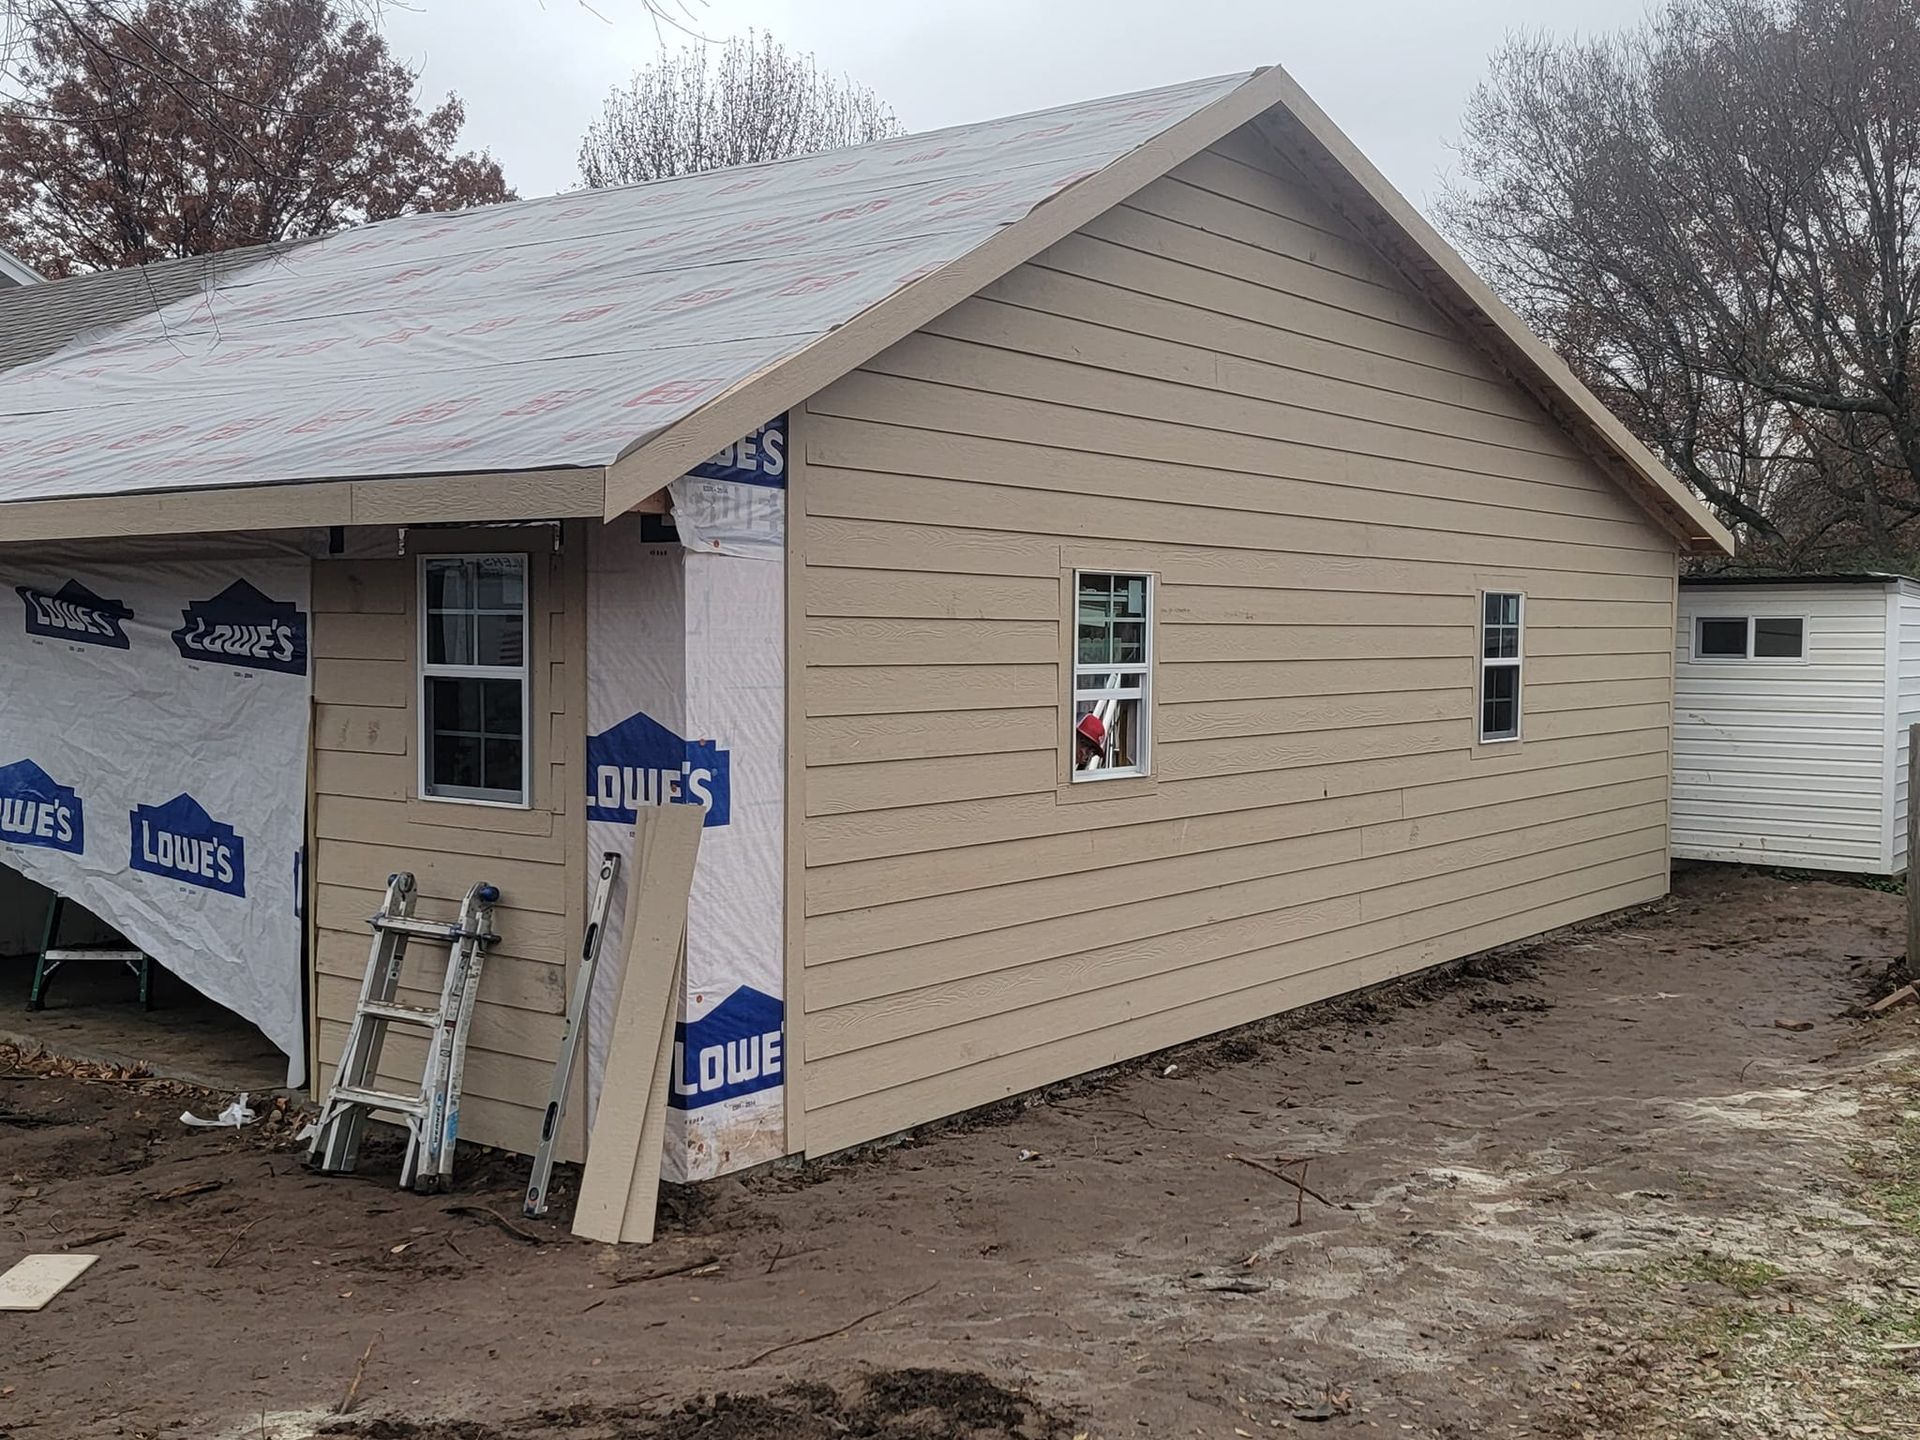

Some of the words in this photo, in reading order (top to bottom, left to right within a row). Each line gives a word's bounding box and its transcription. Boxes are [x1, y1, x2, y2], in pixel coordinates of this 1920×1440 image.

[185, 617, 294, 662] LOWE'S
[0, 798, 73, 842] WE'S
[142, 820, 234, 884] LOWE'S
